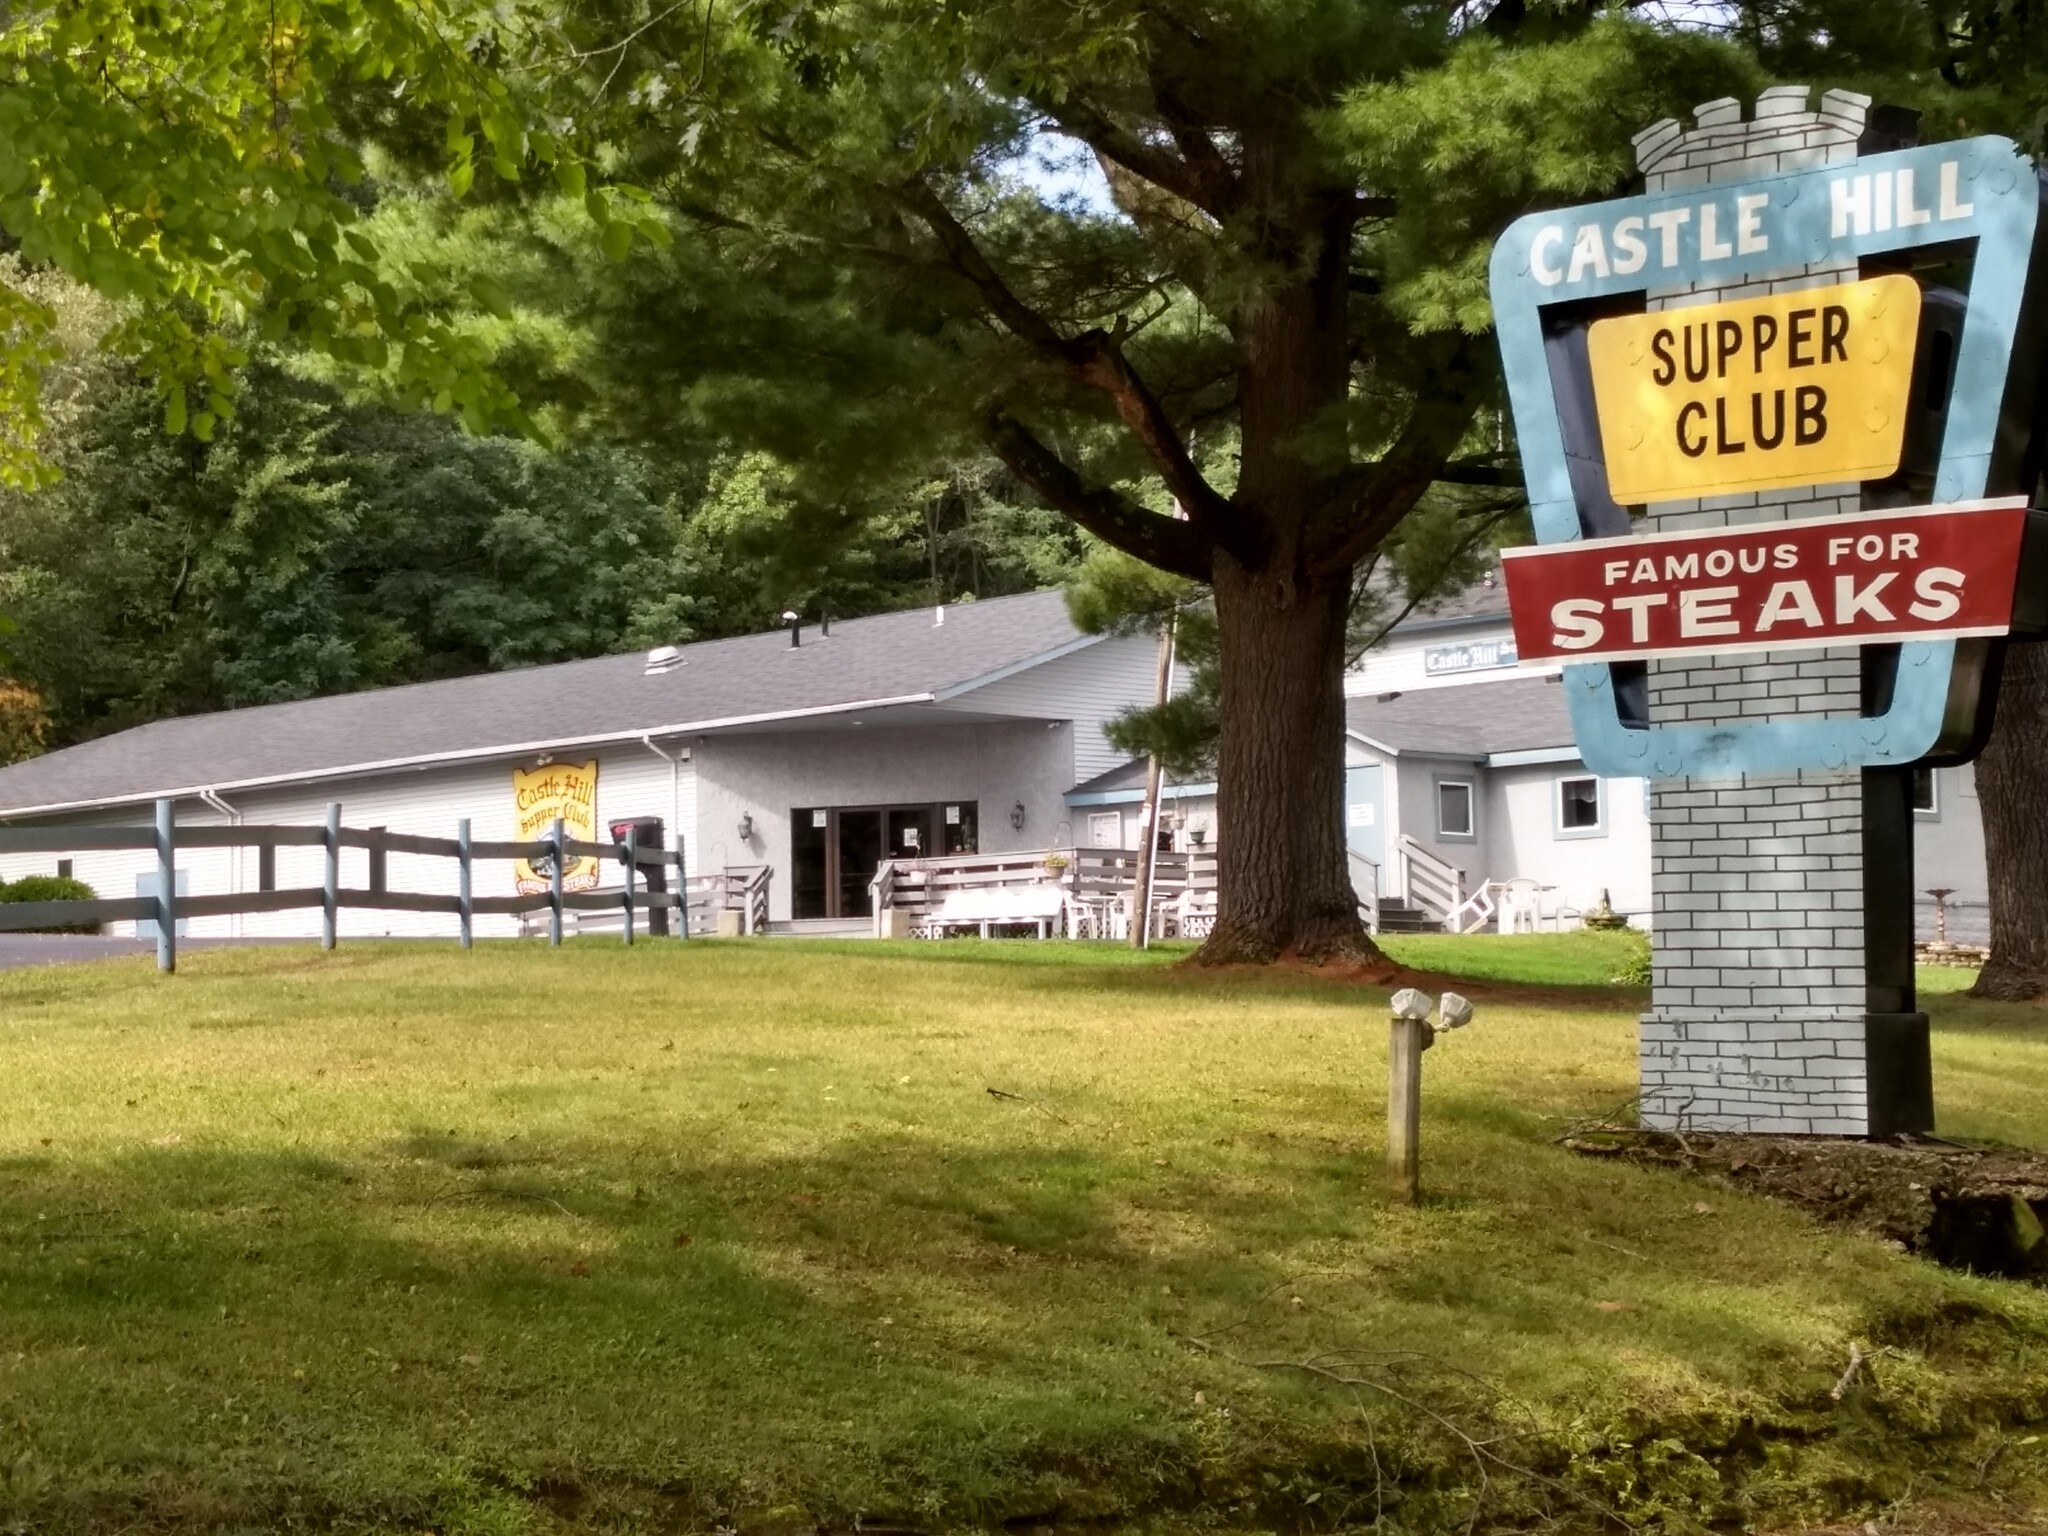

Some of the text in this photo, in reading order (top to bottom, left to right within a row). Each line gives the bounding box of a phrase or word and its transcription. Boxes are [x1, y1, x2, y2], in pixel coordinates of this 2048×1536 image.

[1529, 160, 1974, 287] CASTLE HILL
[1651, 305, 1850, 387] SUPPER
[1676, 385, 1828, 458] CLUB
[1604, 532, 1919, 586] FAMOUS FOR
[1550, 566, 1966, 650] STEAKS
[1427, 651, 1469, 670] Castle
[1470, 645, 1498, 668] Hill
[517, 774, 592, 811] Castle Hill
[520, 806, 560, 834] Supper
